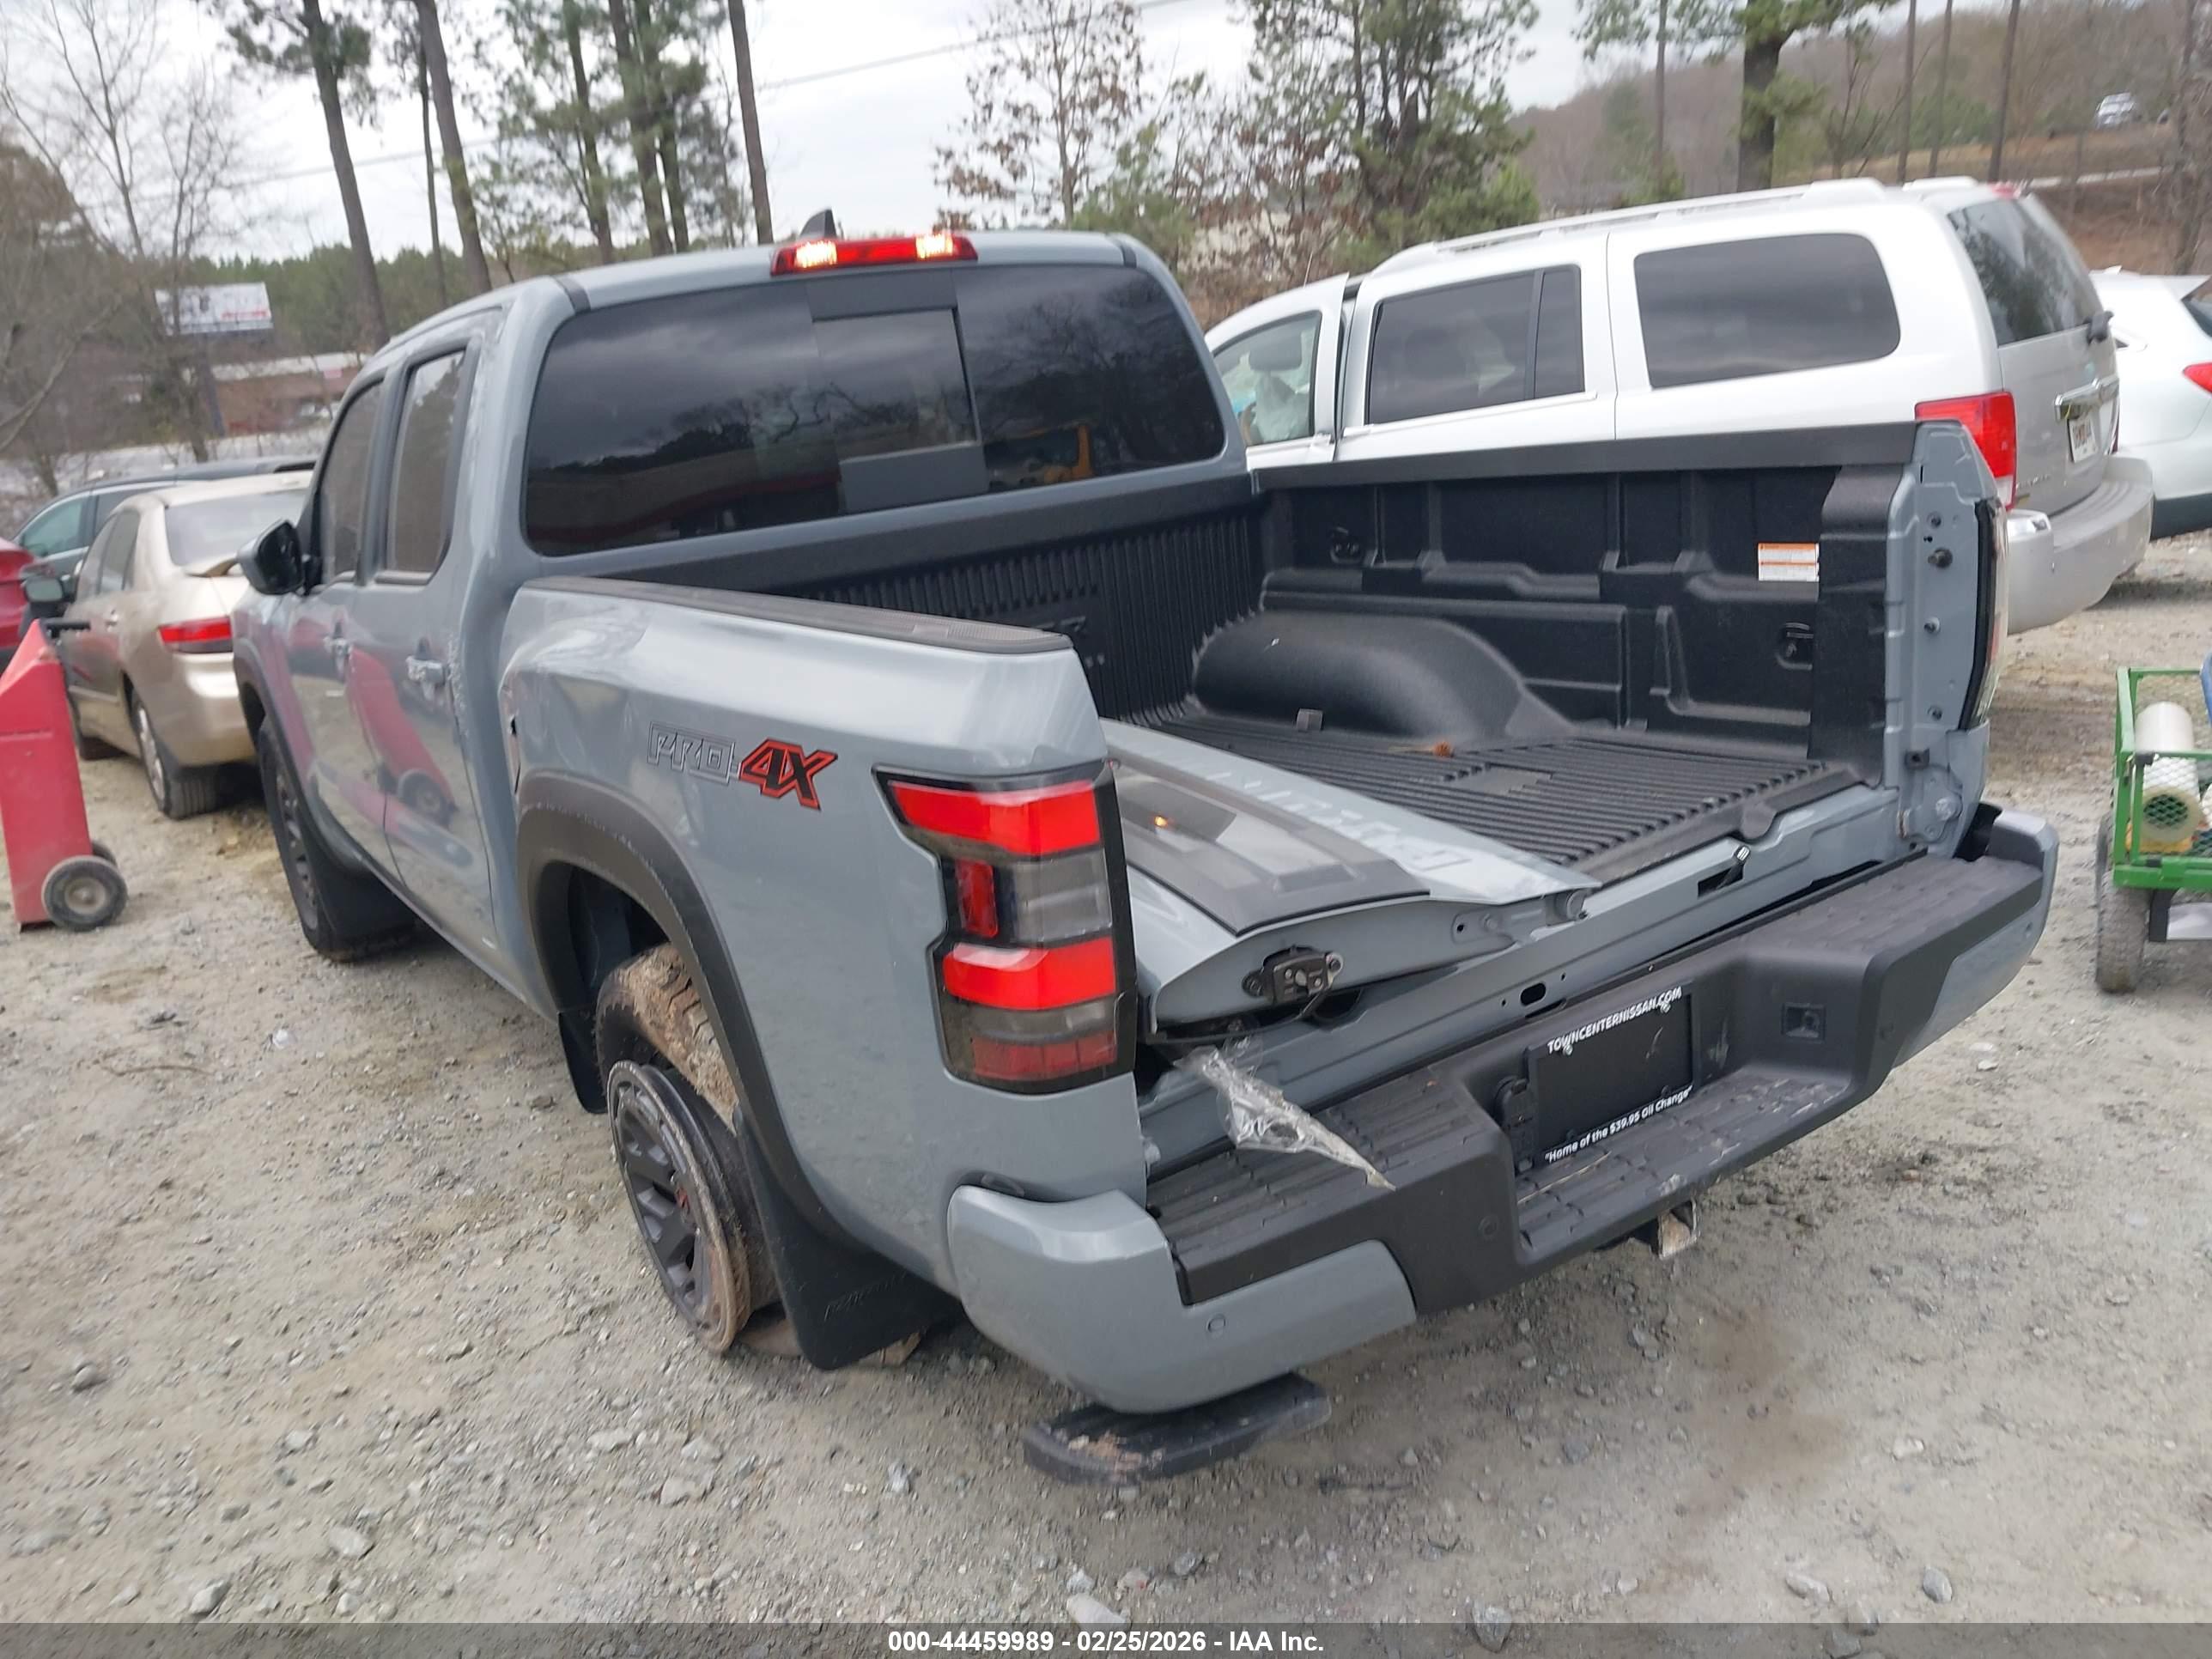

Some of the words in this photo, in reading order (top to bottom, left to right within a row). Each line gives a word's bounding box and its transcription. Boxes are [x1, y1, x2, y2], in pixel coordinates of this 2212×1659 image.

[1547, 986, 1682, 1054] TOWNCENTERNISSAN.COM
[1579, 1134, 1590, 1149] of
[1591, 1127, 1608, 1143] the
[1641, 1104, 1654, 1119] Oil
